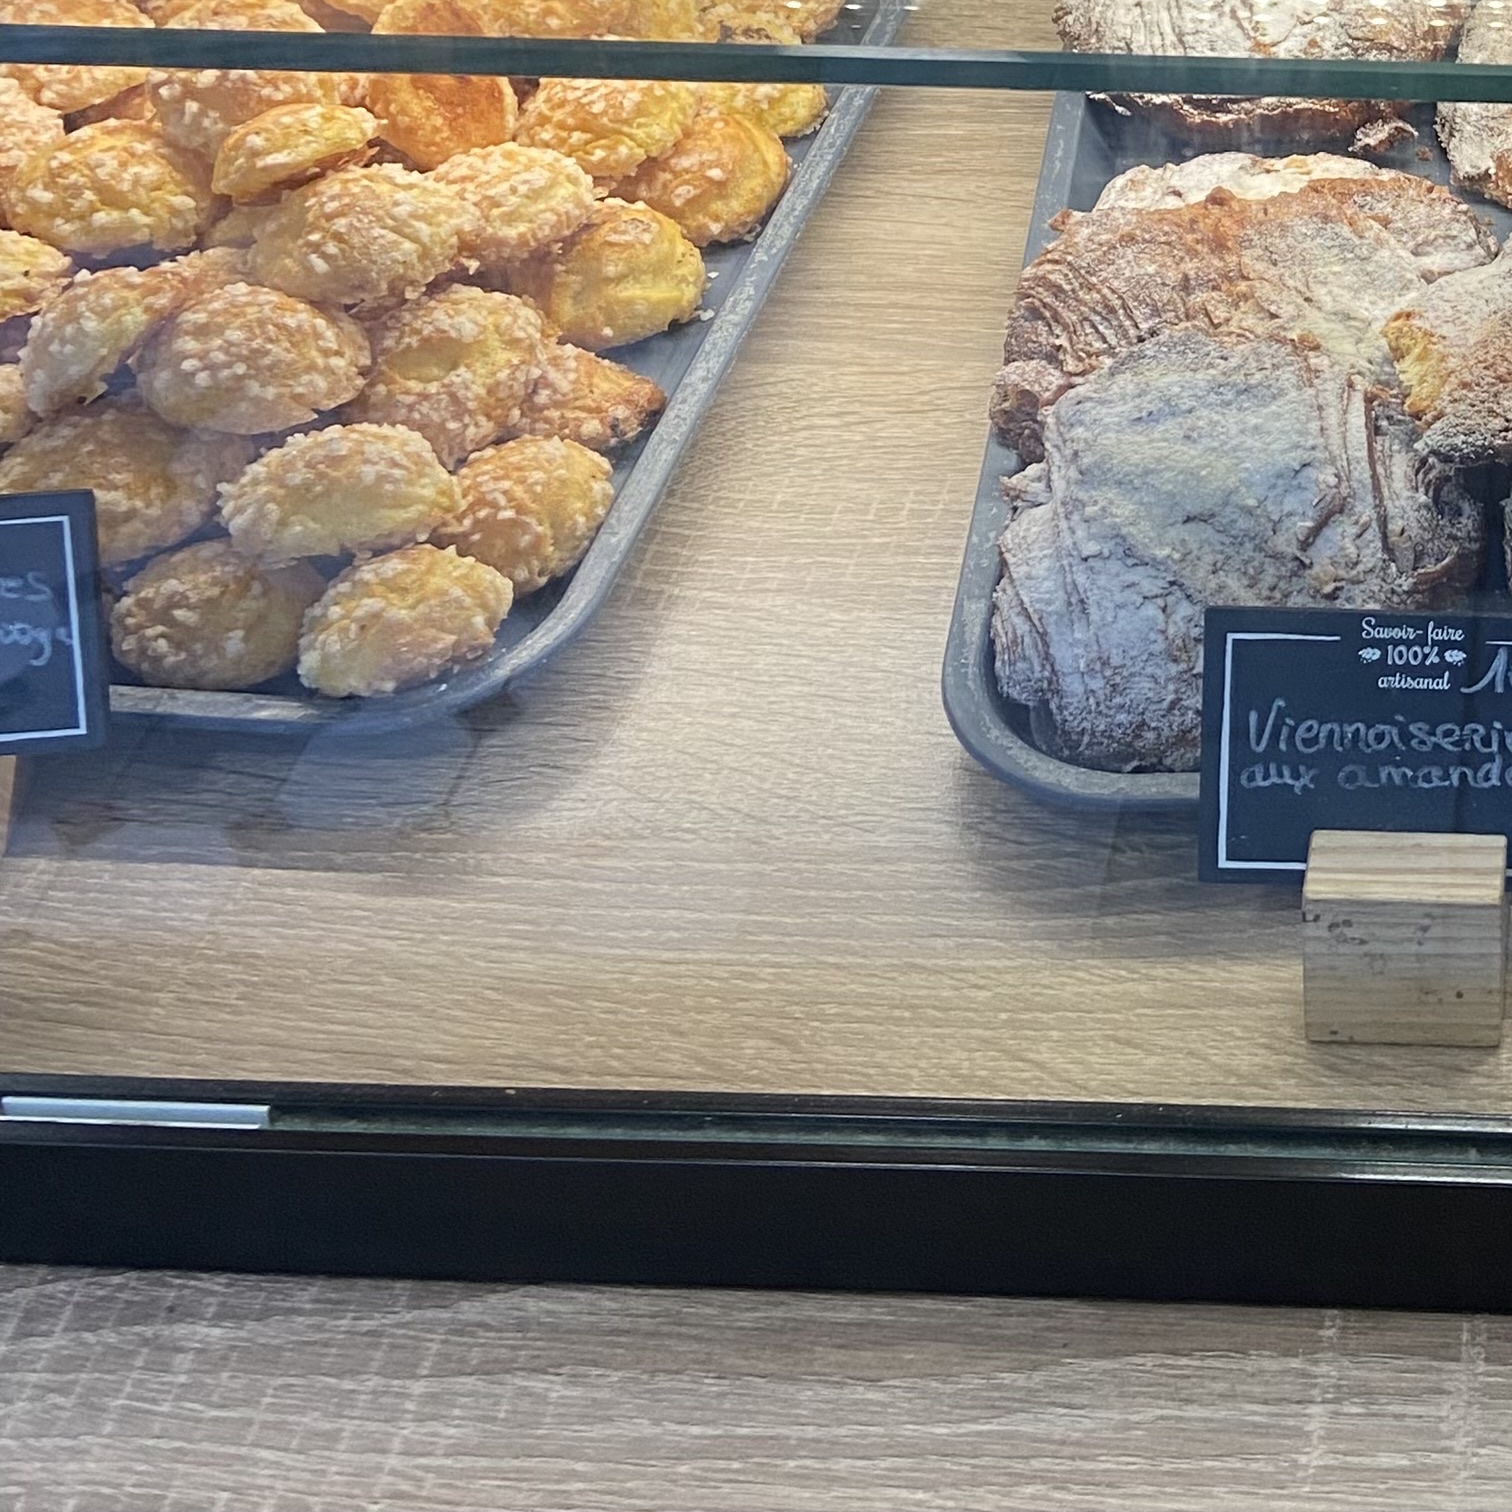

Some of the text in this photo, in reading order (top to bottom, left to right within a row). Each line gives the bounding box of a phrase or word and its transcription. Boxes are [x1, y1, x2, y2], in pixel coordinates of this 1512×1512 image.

[1386, 645, 1442, 667] 100%
[1377, 669, 1452, 692] artisanal
[1239, 760, 1318, 796] aux
